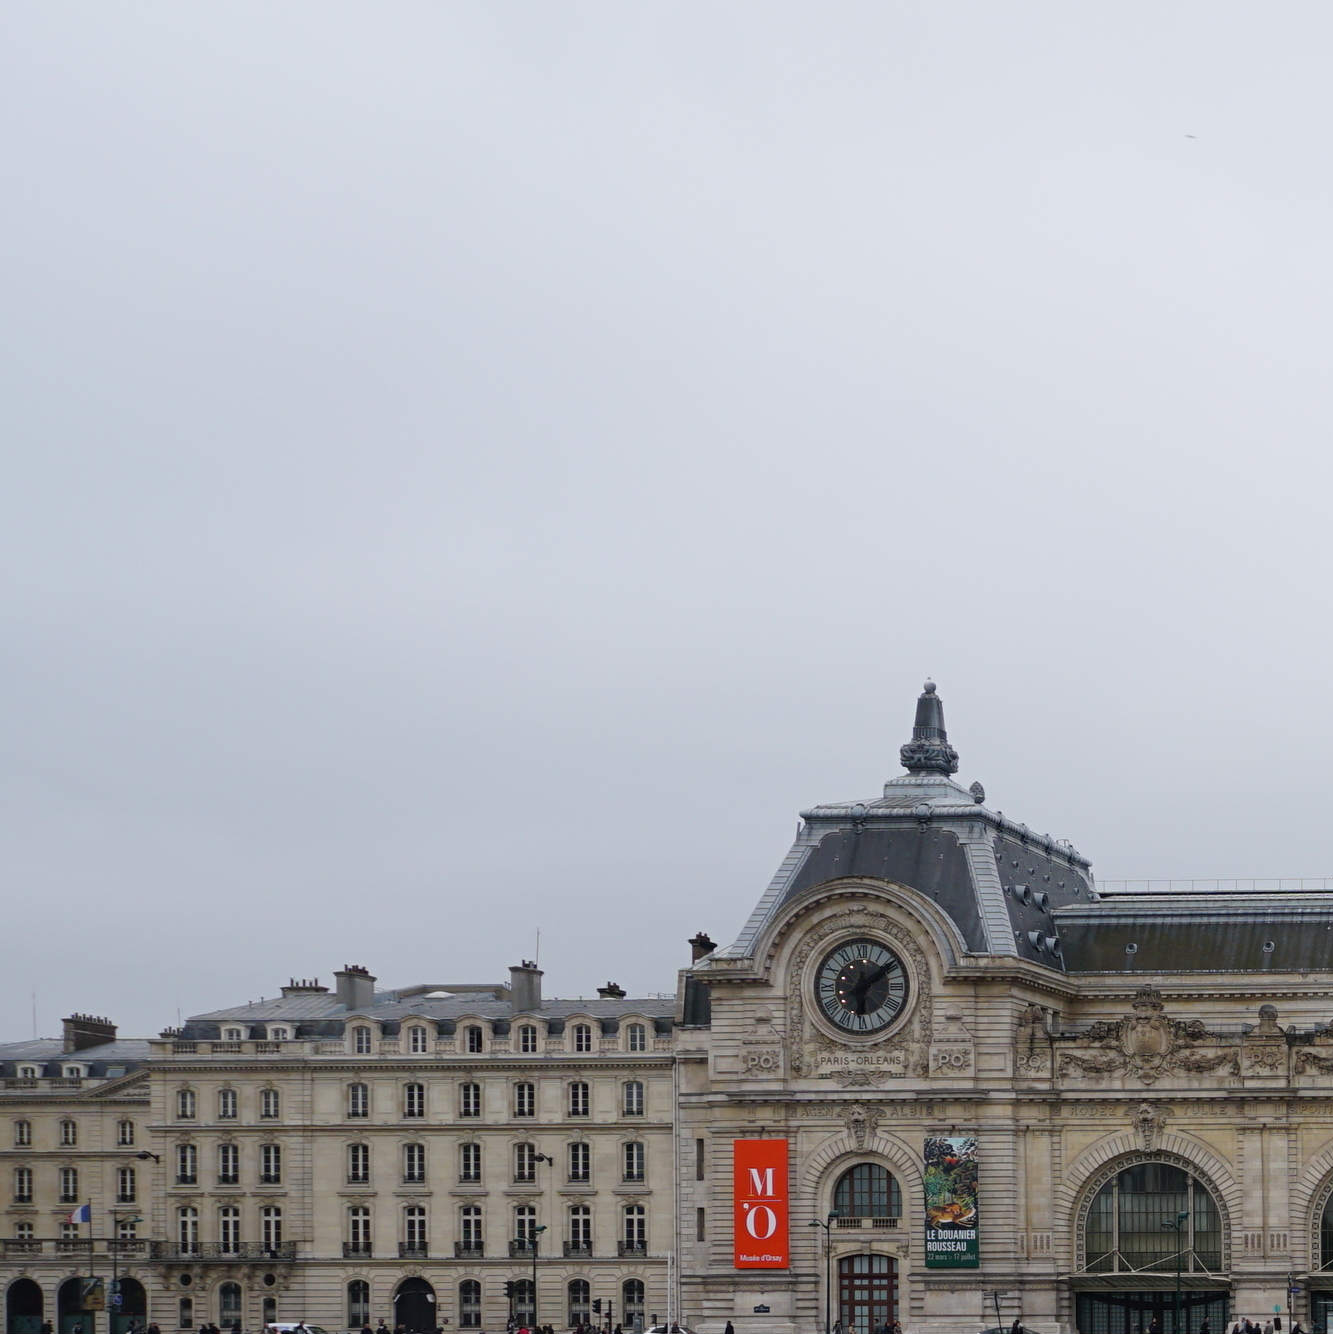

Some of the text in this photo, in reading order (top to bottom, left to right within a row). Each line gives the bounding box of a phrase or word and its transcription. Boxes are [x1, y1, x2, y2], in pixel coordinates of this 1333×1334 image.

[838, 950, 851, 964] XI
[856, 945, 867, 958] XII
[876, 950, 883, 962] I
[825, 964, 839, 975] X
[749, 1056, 773, 1068] PO
[820, 1056, 902, 1066] PARIS-ORLEANS
[938, 1054, 964, 1067] PO
[1016, 1054, 1041, 1068] PO
[1252, 1053, 1276, 1066] PO
[1070, 1106, 1116, 1116] RODEZ
[1182, 1105, 1227, 1114] TULLE
[747, 1168, 776, 1196] M
[927, 1230, 976, 1240] LE DOUANIER
[927, 1242, 967, 1251] ROUSSEAU
